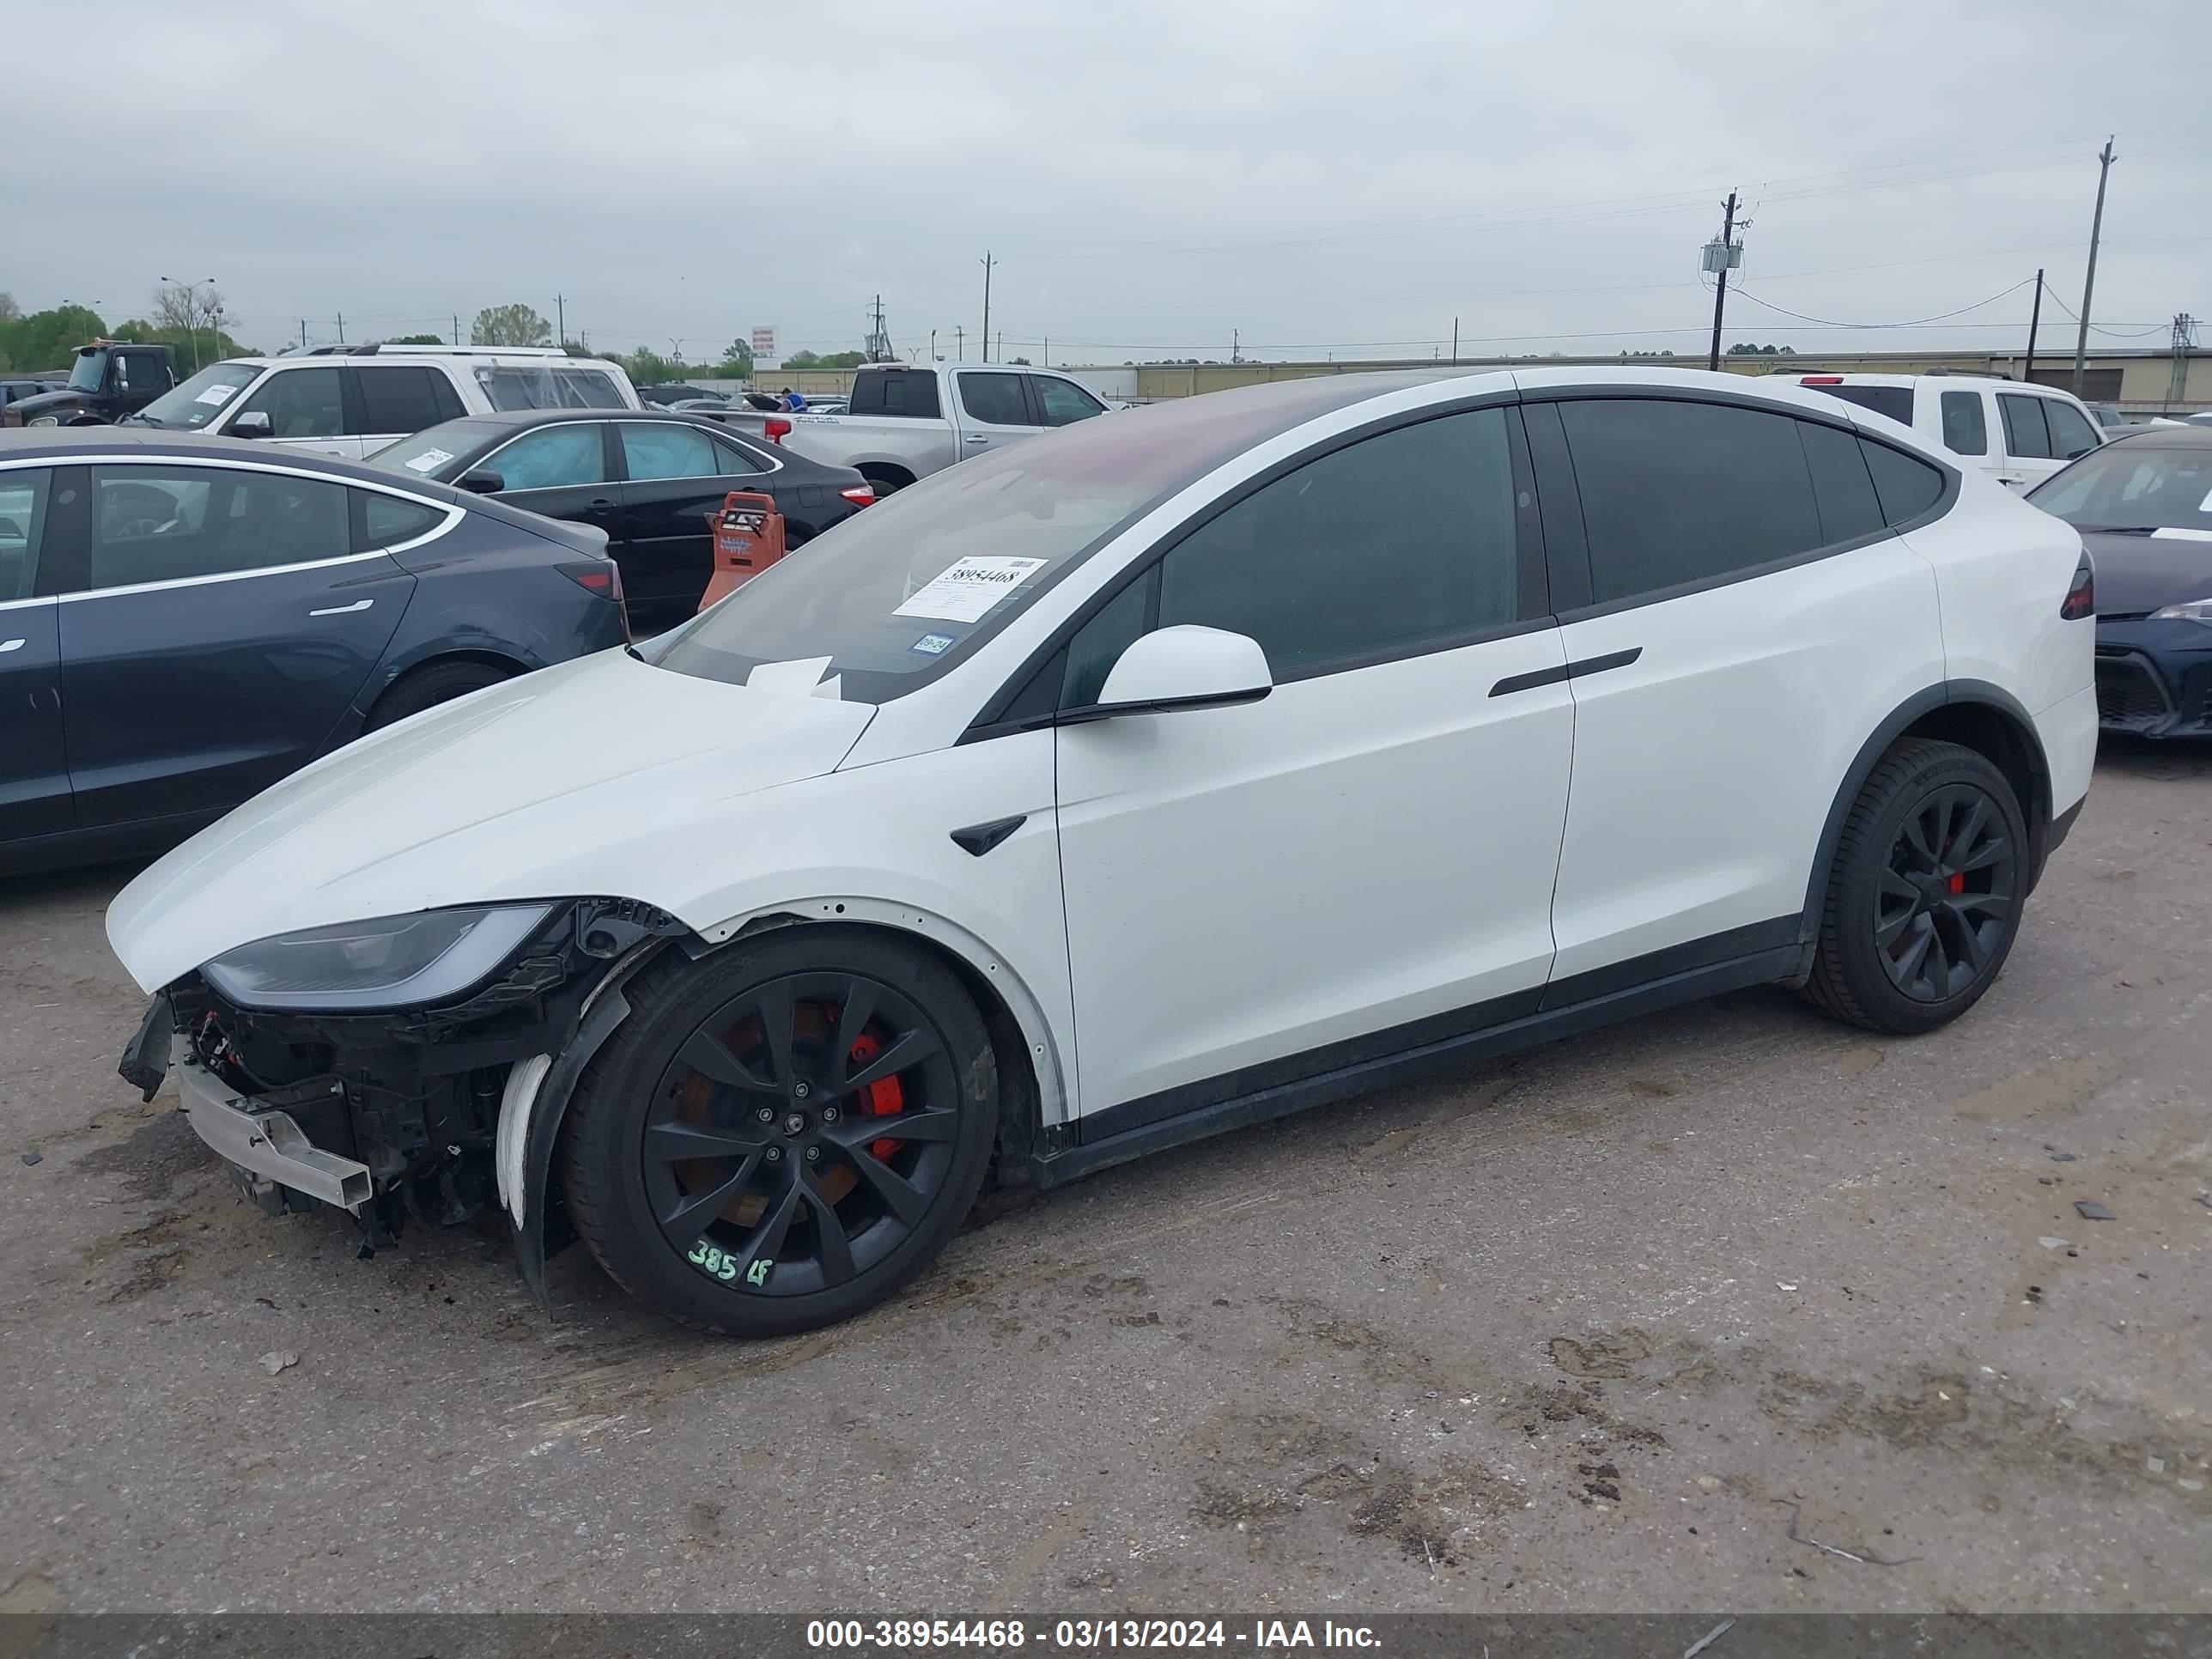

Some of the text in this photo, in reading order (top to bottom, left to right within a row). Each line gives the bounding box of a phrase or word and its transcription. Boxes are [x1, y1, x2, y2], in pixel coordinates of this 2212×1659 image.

[945, 568, 1020, 583] 38954468
[688, 1239, 773, 1286] 385 LF
